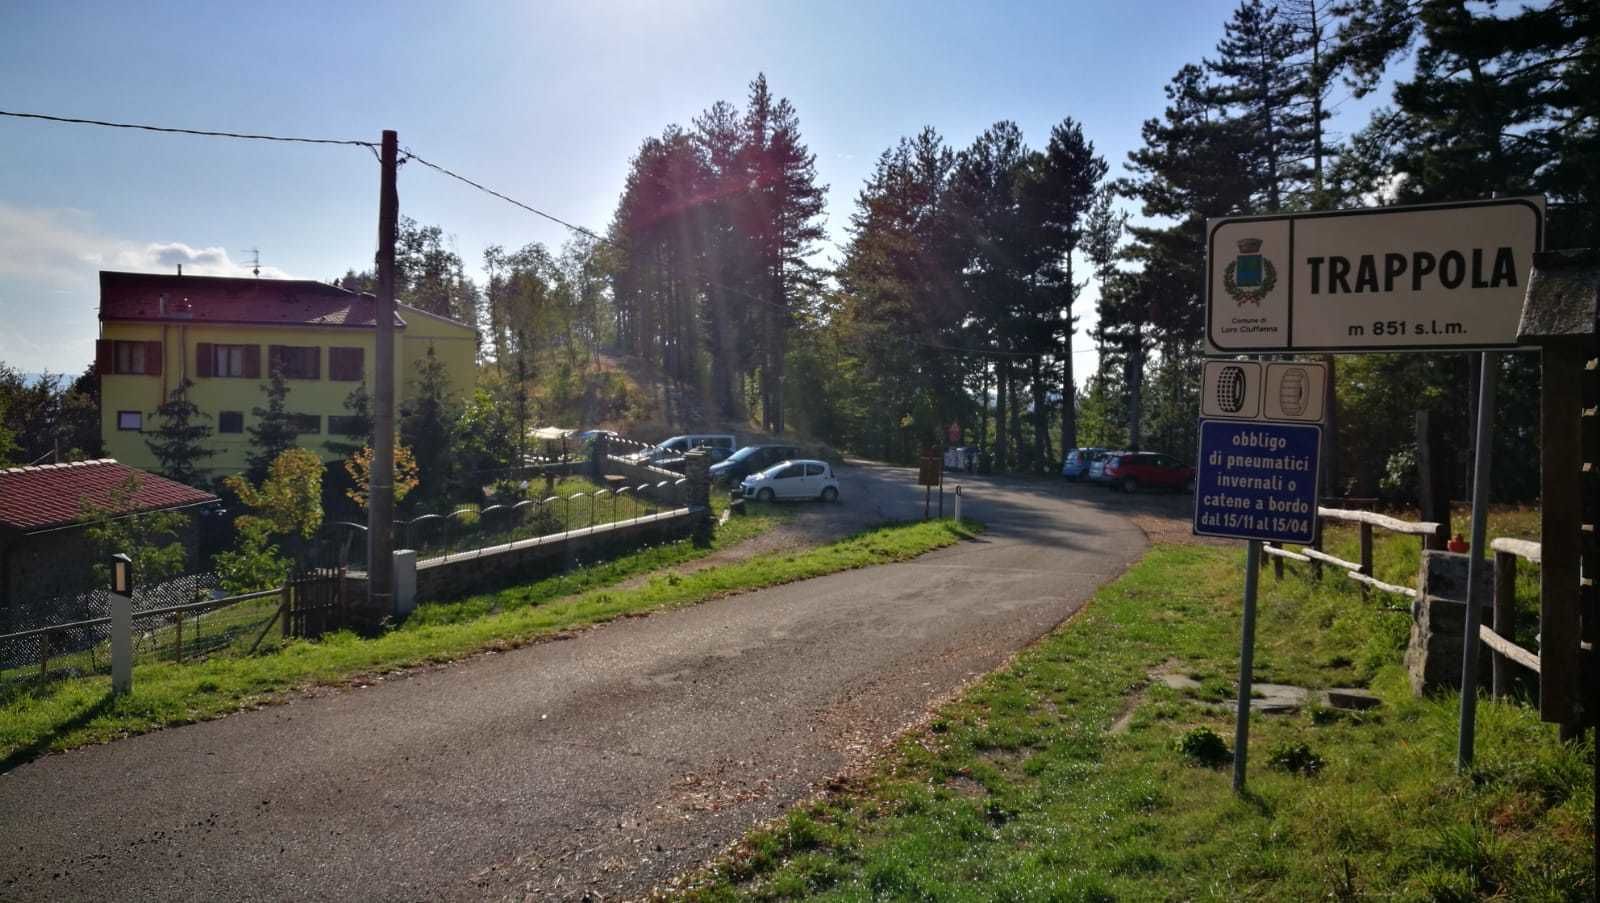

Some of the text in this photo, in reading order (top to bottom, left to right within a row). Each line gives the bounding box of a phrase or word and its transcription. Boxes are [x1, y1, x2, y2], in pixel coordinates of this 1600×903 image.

[1307, 247, 1518, 294] TRAPPOLA
[1348, 320, 1467, 336] m 851 s.l.m.
[1232, 432, 1286, 451] obbligo
[1209, 451, 1309, 471] di pneumatici
[1217, 472, 1297, 491] invernali o
[1203, 494, 1309, 513] catene a bordo
[1201, 512, 1308, 534] dal 15/11 al 15/04
